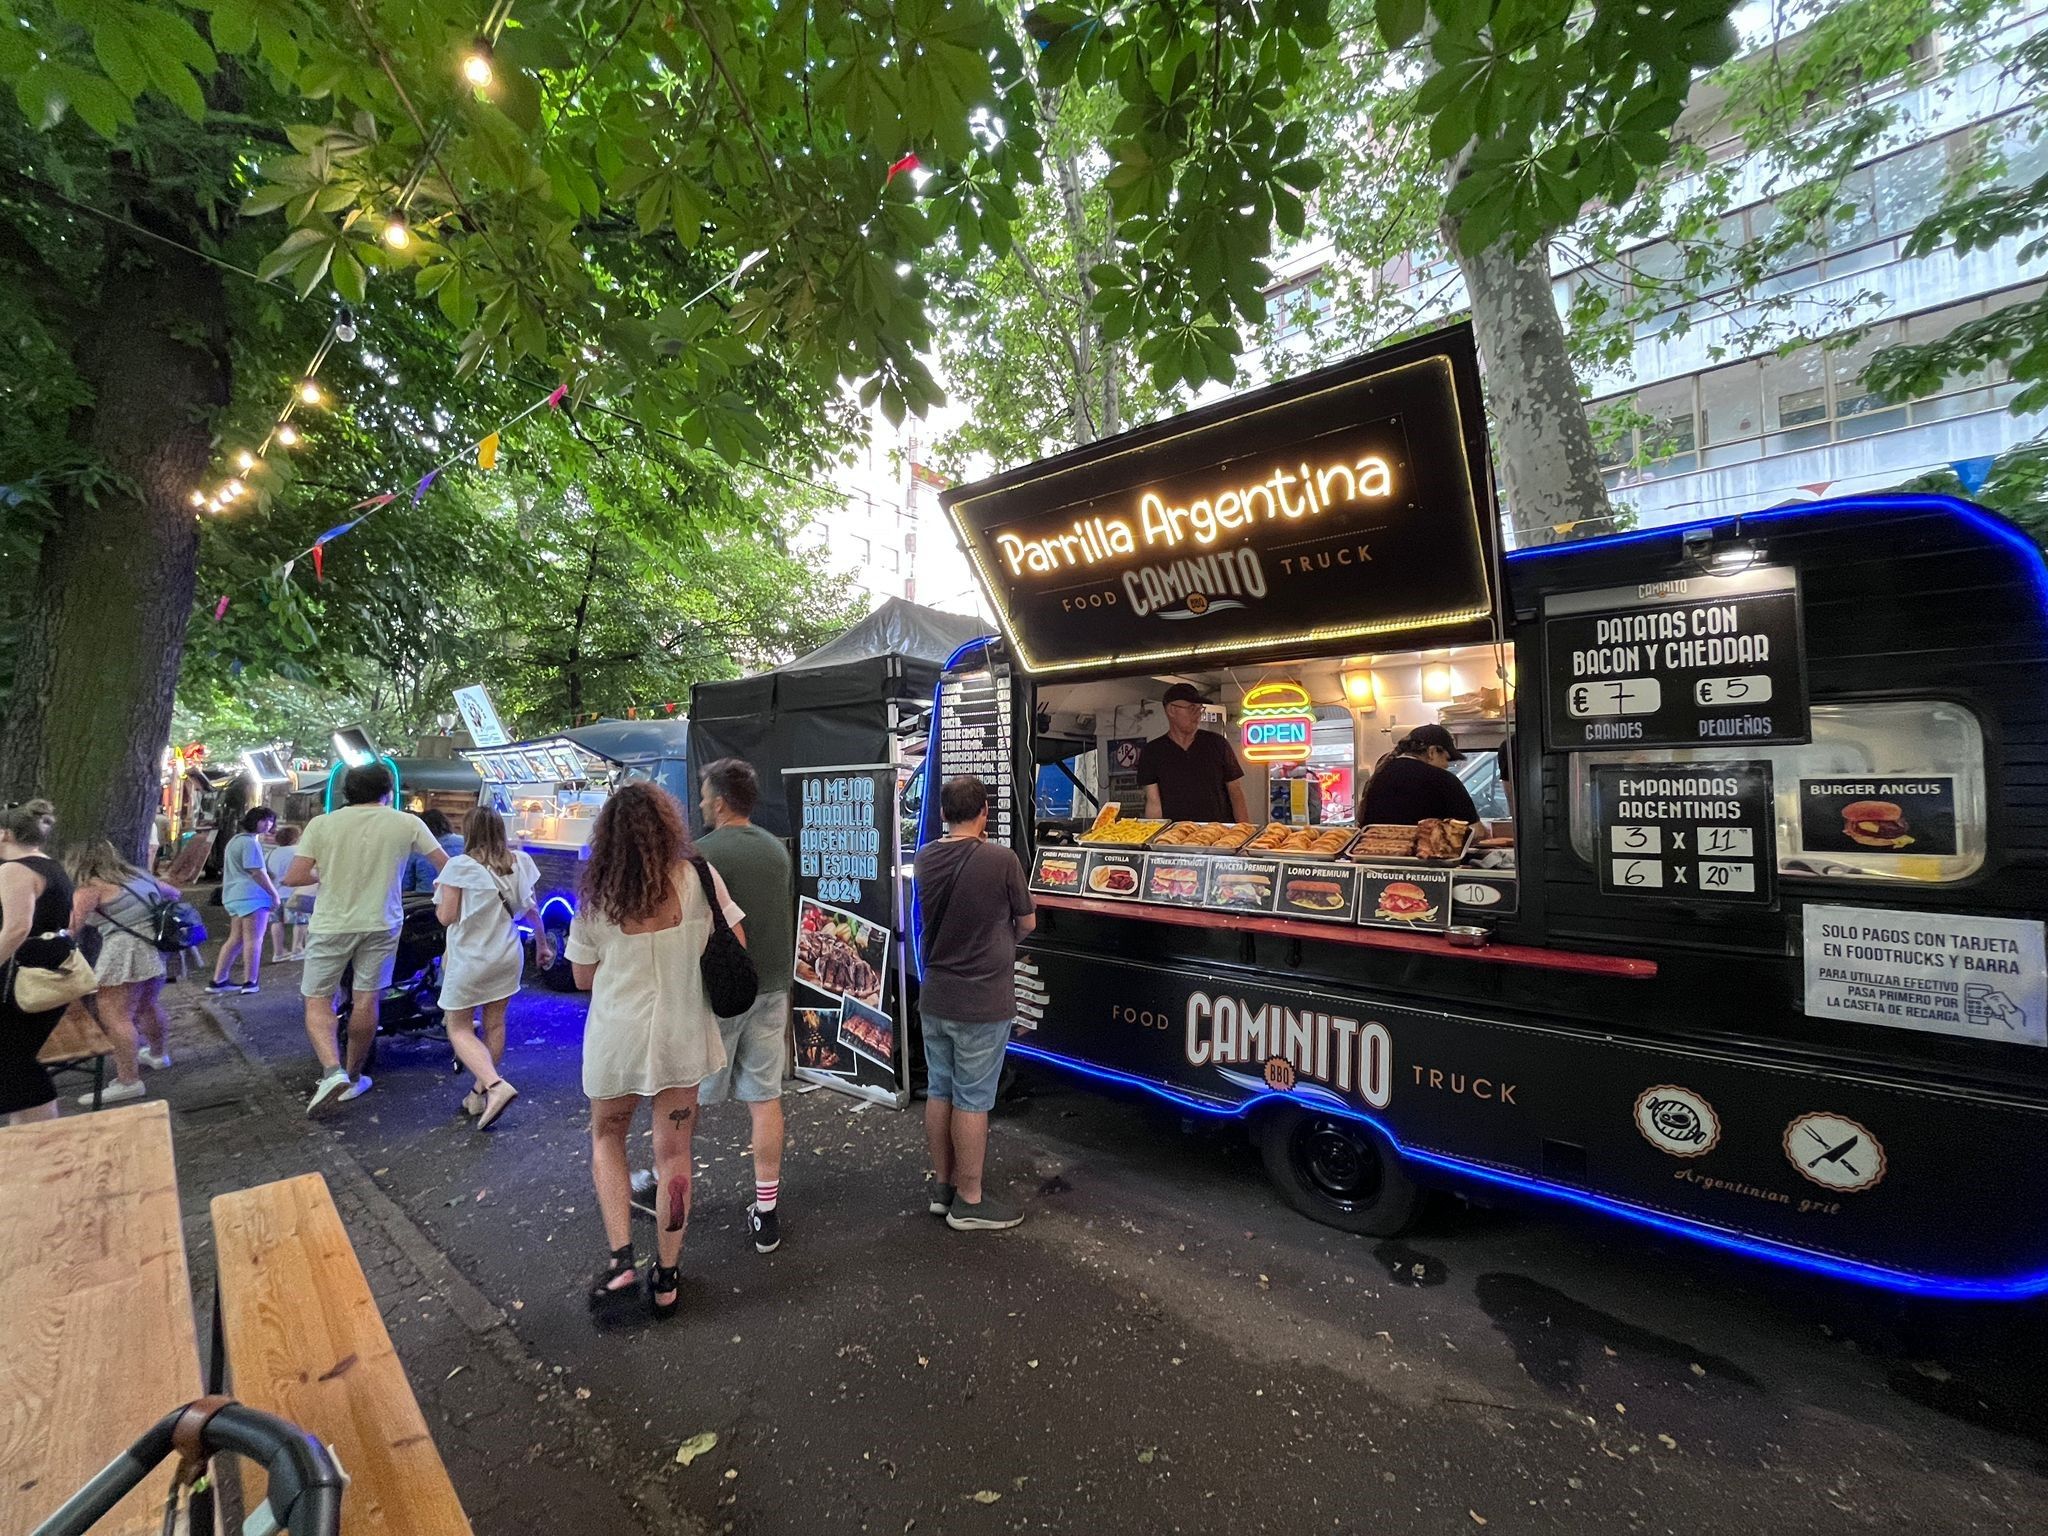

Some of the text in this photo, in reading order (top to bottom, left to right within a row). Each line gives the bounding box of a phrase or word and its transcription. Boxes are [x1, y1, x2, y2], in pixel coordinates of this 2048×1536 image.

[997, 456, 1393, 577] Parrilla Argentina
[1061, 545, 1374, 618] FOOD CAMINITO TRUCK
[1638, 580, 1688, 600] CAMINITO
[1597, 605, 1737, 645] PATATAS CON
[1573, 634, 1770, 676] BACON Y CHEDDAR
[1604, 683, 1635, 715] 7
[1726, 679, 1749, 698] 5
[1247, 723, 1306, 744] OPEN
[1585, 722, 1643, 741] GRANDES
[1699, 714, 1772, 737] PEQUEÑAS
[802, 777, 874, 803] LA MEJOR
[1619, 778, 1738, 797] EMPANADAS
[1810, 783, 1941, 795] BURGER ANGUS
[802, 802, 874, 828] PARRILLA
[1618, 801, 1741, 819] ARGENTINAS
[800, 827, 880, 855] ARGENTINA
[1624, 827, 1648, 848] 3
[801, 852, 820, 877] EN
[1215, 863, 1276, 873] PANCETA PREMIUM
[1288, 867, 1350, 878] LOMO PREMIUM
[1624, 861, 1646, 885] 6
[1366, 872, 1447, 883] BURGUER PREMIUM
[817, 877, 861, 903] 2024
[1464, 885, 1486, 903] 10
[1822, 924, 2020, 954] SOLO PAGOS CON TARJETA
[1824, 943, 2020, 974] EN FOODTRUCKS Y BARRA
[1819, 968, 1959, 993] PARA UTILIZAR EFECTIVO
[1827, 996, 1961, 1022] LA CASETA DE RECARGA
[1848, 986, 1959, 1008] PASA PRIMERO POR
[1112, 990, 1517, 1109] FOOD CAMINITO TRUCK
[1268, 1065, 1289, 1085] BBQ
[1674, 1170, 1790, 1203] Argentinian
